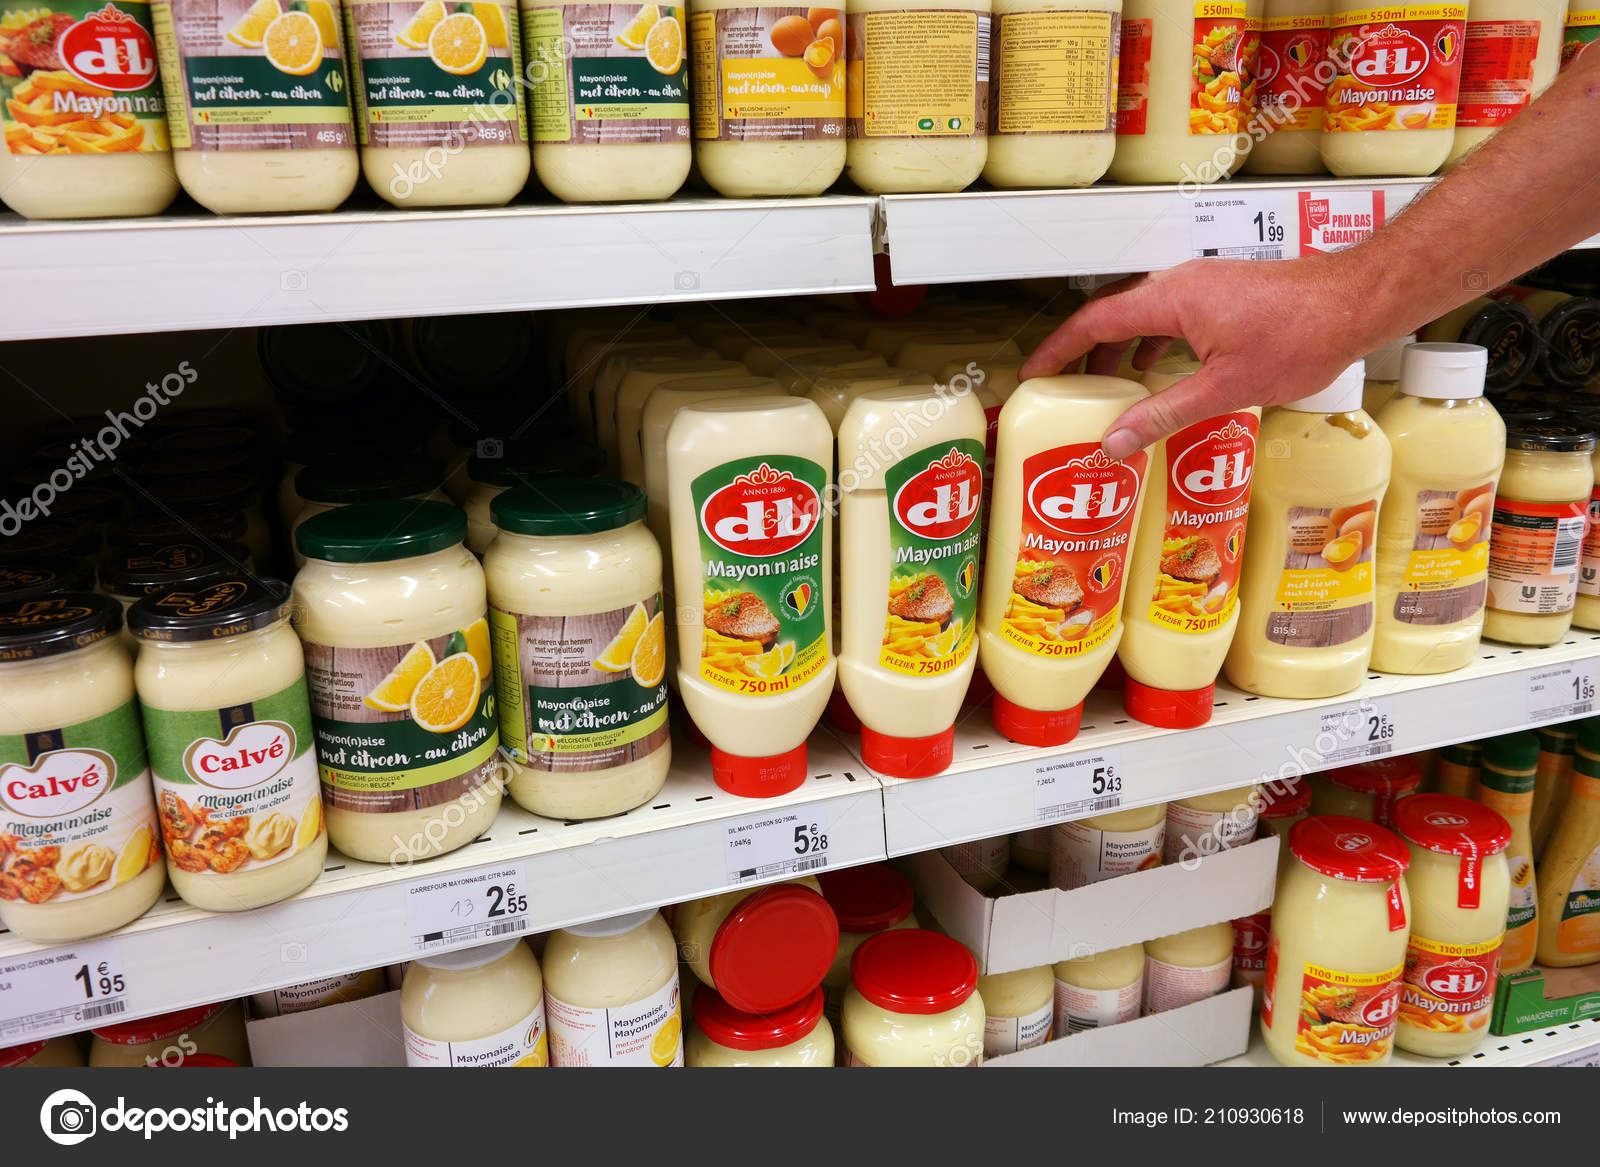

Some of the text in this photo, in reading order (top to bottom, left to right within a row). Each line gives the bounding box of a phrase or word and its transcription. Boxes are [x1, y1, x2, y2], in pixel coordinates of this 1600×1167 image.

[1203, 5, 1233, 15] 550ml
[73, 37, 152, 75] d&L
[1355, 47, 1421, 76] d&L
[580, 85, 602, 98] met
[604, 84, 641, 98] citroen
[1340, 83, 1435, 107] Mayon(n)aise
[1253, 211, 1275, 242] 1 €
[1332, 214, 1371, 228] PRIX BAS
[1268, 225, 1284, 242] 99
[1073, 471, 1099, 479] ANNO
[1183, 450, 1251, 494] d&L
[742, 486, 786, 496] ANNO 1886
[1040, 481, 1131, 520] d&L
[906, 479, 979, 526] d&L
[714, 496, 812, 542] d&L
[1170, 502, 1250, 529] Mayon(n)aise
[1025, 531, 1128, 556] Mayon(n)aise
[707, 553, 819, 582] Mayon(n)aise
[1153, 609, 1221, 632] PLEZIER 750 ml
[1400, 606, 1416, 614] 815
[143, 628, 173, 640] Calvé
[212, 621, 249, 638] Calvé
[1272, 626, 1288, 635] 815
[562, 645, 585, 654] uitloop
[569, 637, 593, 645] hennen
[1004, 628, 1034, 649] PLEZIER
[1036, 641, 1063, 656] 750
[1064, 640, 1083, 656] ml
[561, 660, 570, 668] de
[570, 659, 591, 668] poules
[703, 654, 827, 694] PLEZIER 750 ml DE PLAISIR
[884, 655, 915, 671] PLEZIER
[918, 660, 942, 674] 750
[942, 655, 958, 671] ml
[1572, 676, 1580, 701] 1
[1582, 675, 1589, 687] €
[1582, 684, 1596, 700] 95
[537, 697, 610, 712] Mayon(n)aise
[538, 701, 655, 731] met citroen au
[318, 729, 386, 747] Mayon(n)aise
[1367, 714, 1388, 742] 2 €
[1380, 724, 1395, 739] 65
[320, 726, 488, 769] met citroen au citron
[556, 736, 592, 744] BELGISCHE
[199, 735, 285, 775] Calvé
[6, 763, 101, 801] Calvé
[335, 772, 367, 782] BELGISCHE
[1092, 766, 1114, 795] 5 €
[1106, 777, 1122, 793] 43
[197, 775, 295, 809] Mayon(n)aise
[225, 805, 255, 819] citroen
[259, 802, 269, 811] au
[269, 793, 292, 808] citron
[6, 805, 113, 838] Mayon(n)aise
[754, 820, 774, 830] CITRON
[33, 833, 66, 848] citroen
[71, 832, 82, 841] au
[82, 823, 109, 838] citron
[793, 823, 819, 855] 5 €
[810, 834, 828, 853] 28
[1105, 838, 1150, 850] Mayonaise
[1104, 846, 1152, 860] Mayonnaise
[410, 881, 448, 895] CARREFOUR
[447, 874, 487, 888] MAYONNAISE
[487, 871, 501, 880] CITR
[486, 883, 516, 918] 2 €
[507, 894, 528, 914] 55
[27, 957, 55, 969] CITRON
[74, 961, 110, 999] 1 €
[99, 974, 125, 996] 95
[279, 979, 341, 1000] Mayonnaise
[1430, 973, 1483, 994] d&L
[613, 1003, 664, 1029] Mayonaise
[614, 1010, 669, 1040] Mayonnaise
[1515, 1006, 1570, 1025] VINAIGRETTE
[615, 1032, 653, 1050] met citroen
[624, 1044, 645, 1054] citron
[456, 1042, 515, 1065] Mayonaise
